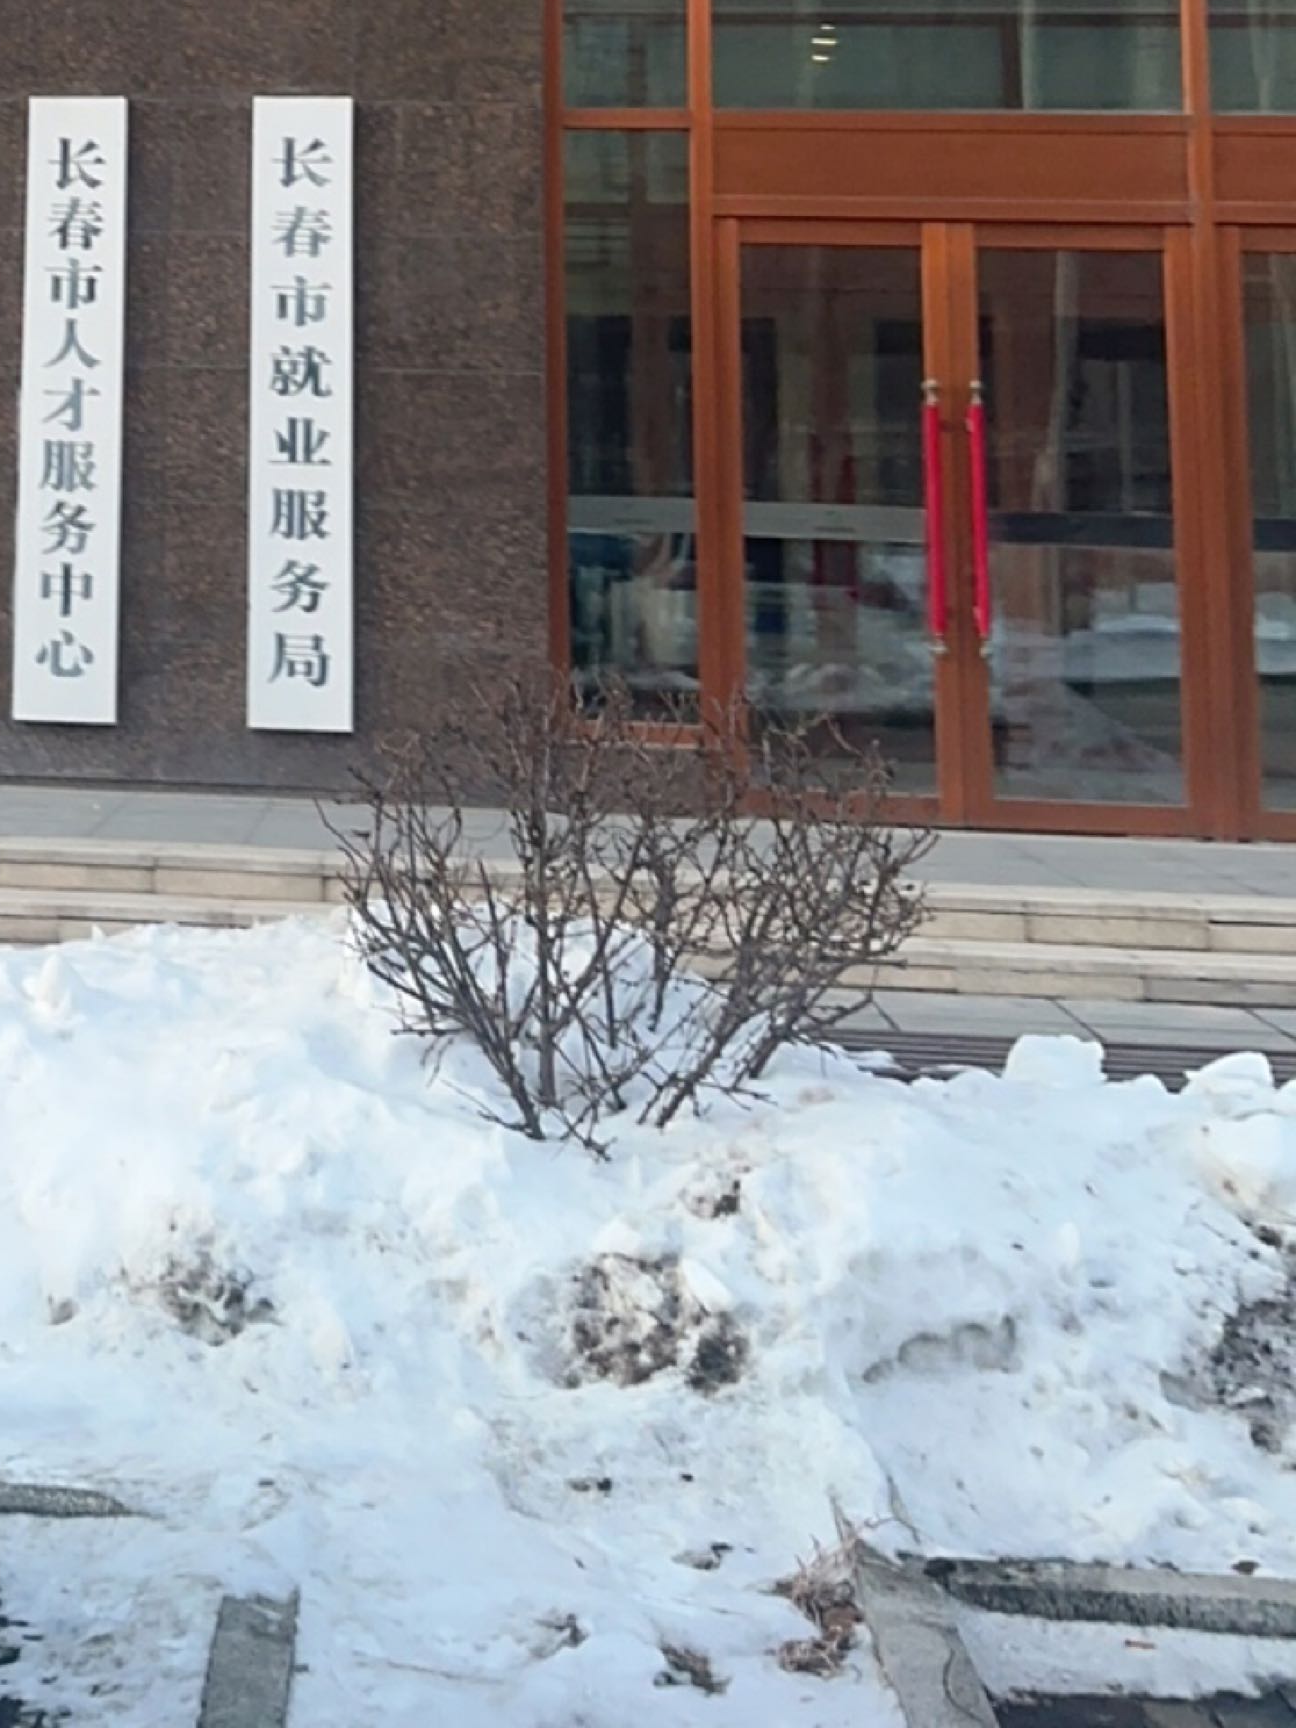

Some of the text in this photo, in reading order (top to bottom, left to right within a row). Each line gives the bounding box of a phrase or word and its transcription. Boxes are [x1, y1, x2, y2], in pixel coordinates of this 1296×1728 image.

[35, 137, 104, 678] 长春市人才服务中心
[268, 136, 332, 688] 长春市就业服务局
